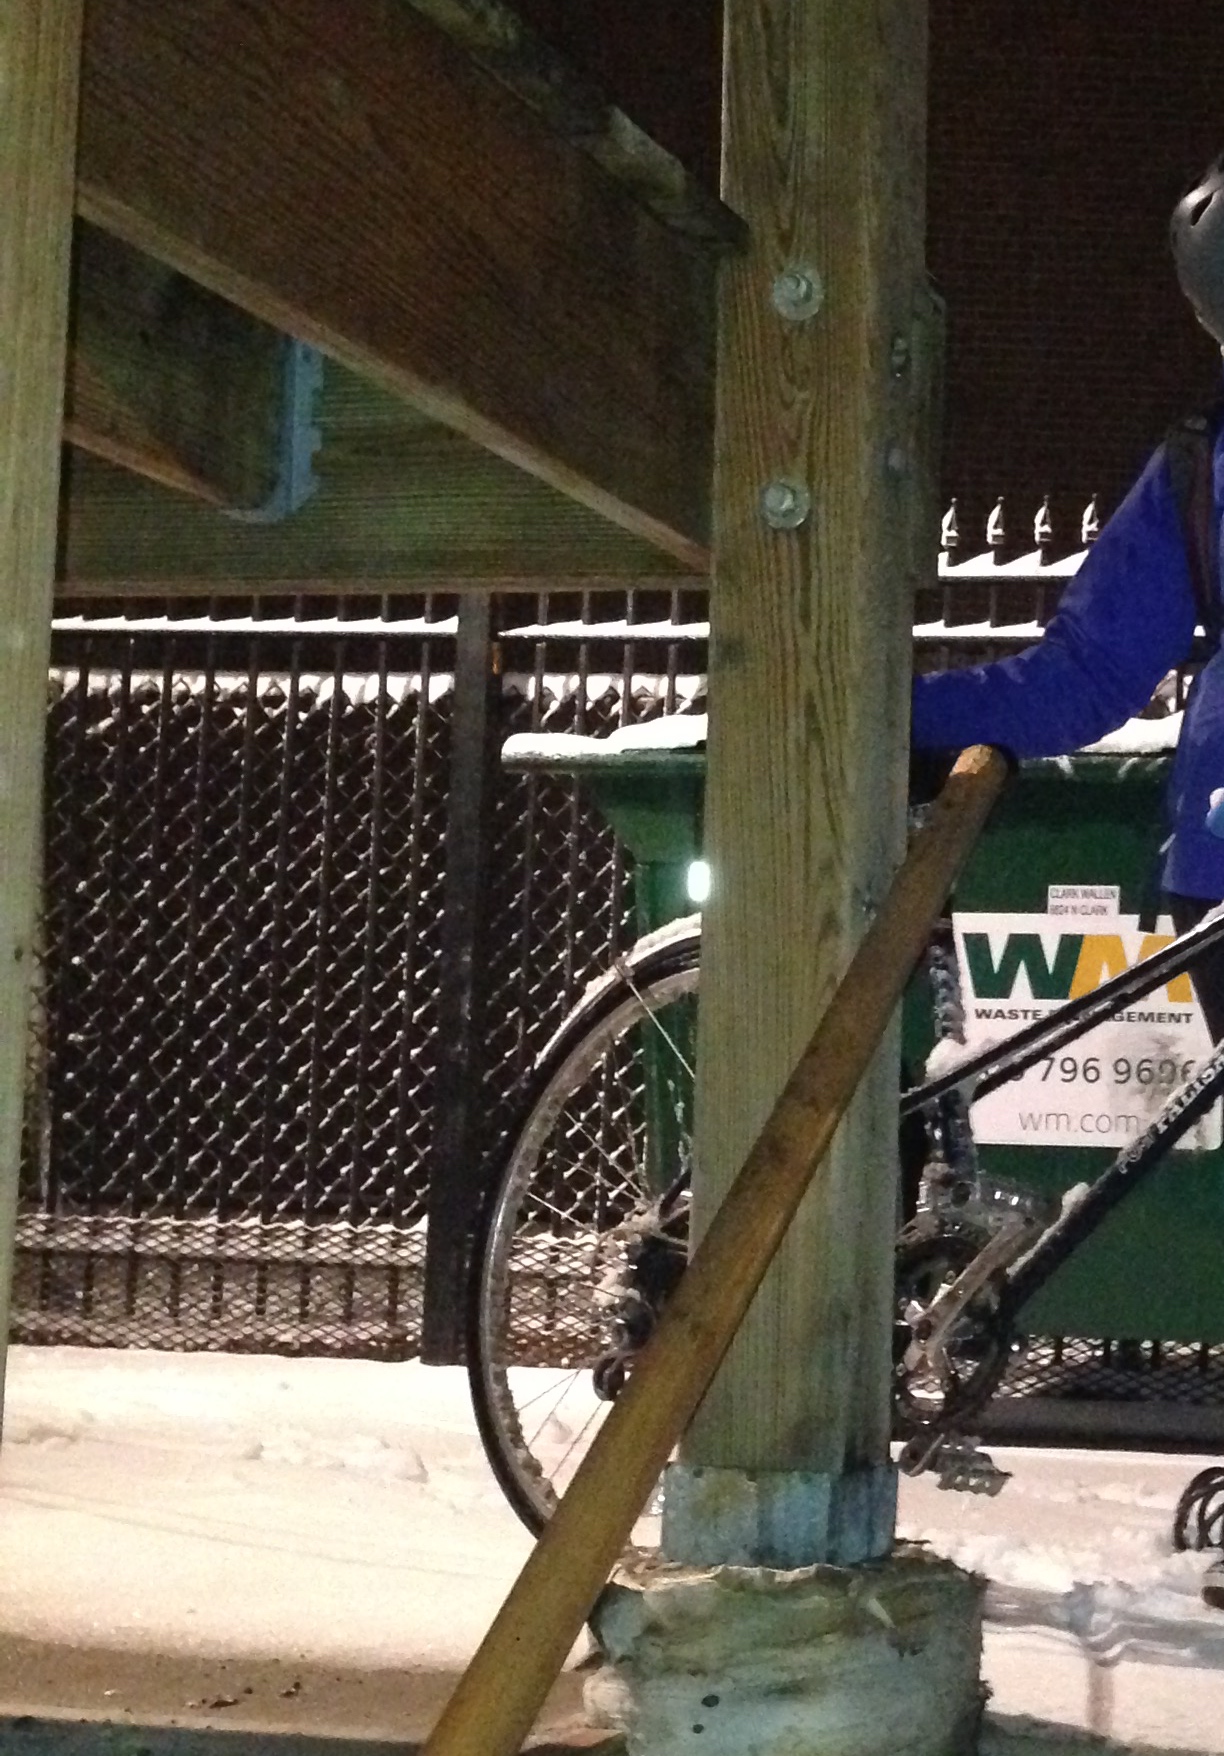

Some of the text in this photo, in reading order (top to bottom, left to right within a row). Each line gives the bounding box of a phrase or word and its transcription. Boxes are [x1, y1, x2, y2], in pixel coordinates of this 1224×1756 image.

[975, 1008, 1194, 1024] WASTE GEMENT
[1040, 1056, 1100, 1084] 796
[1018, 1110, 1140, 1134] wm.com
